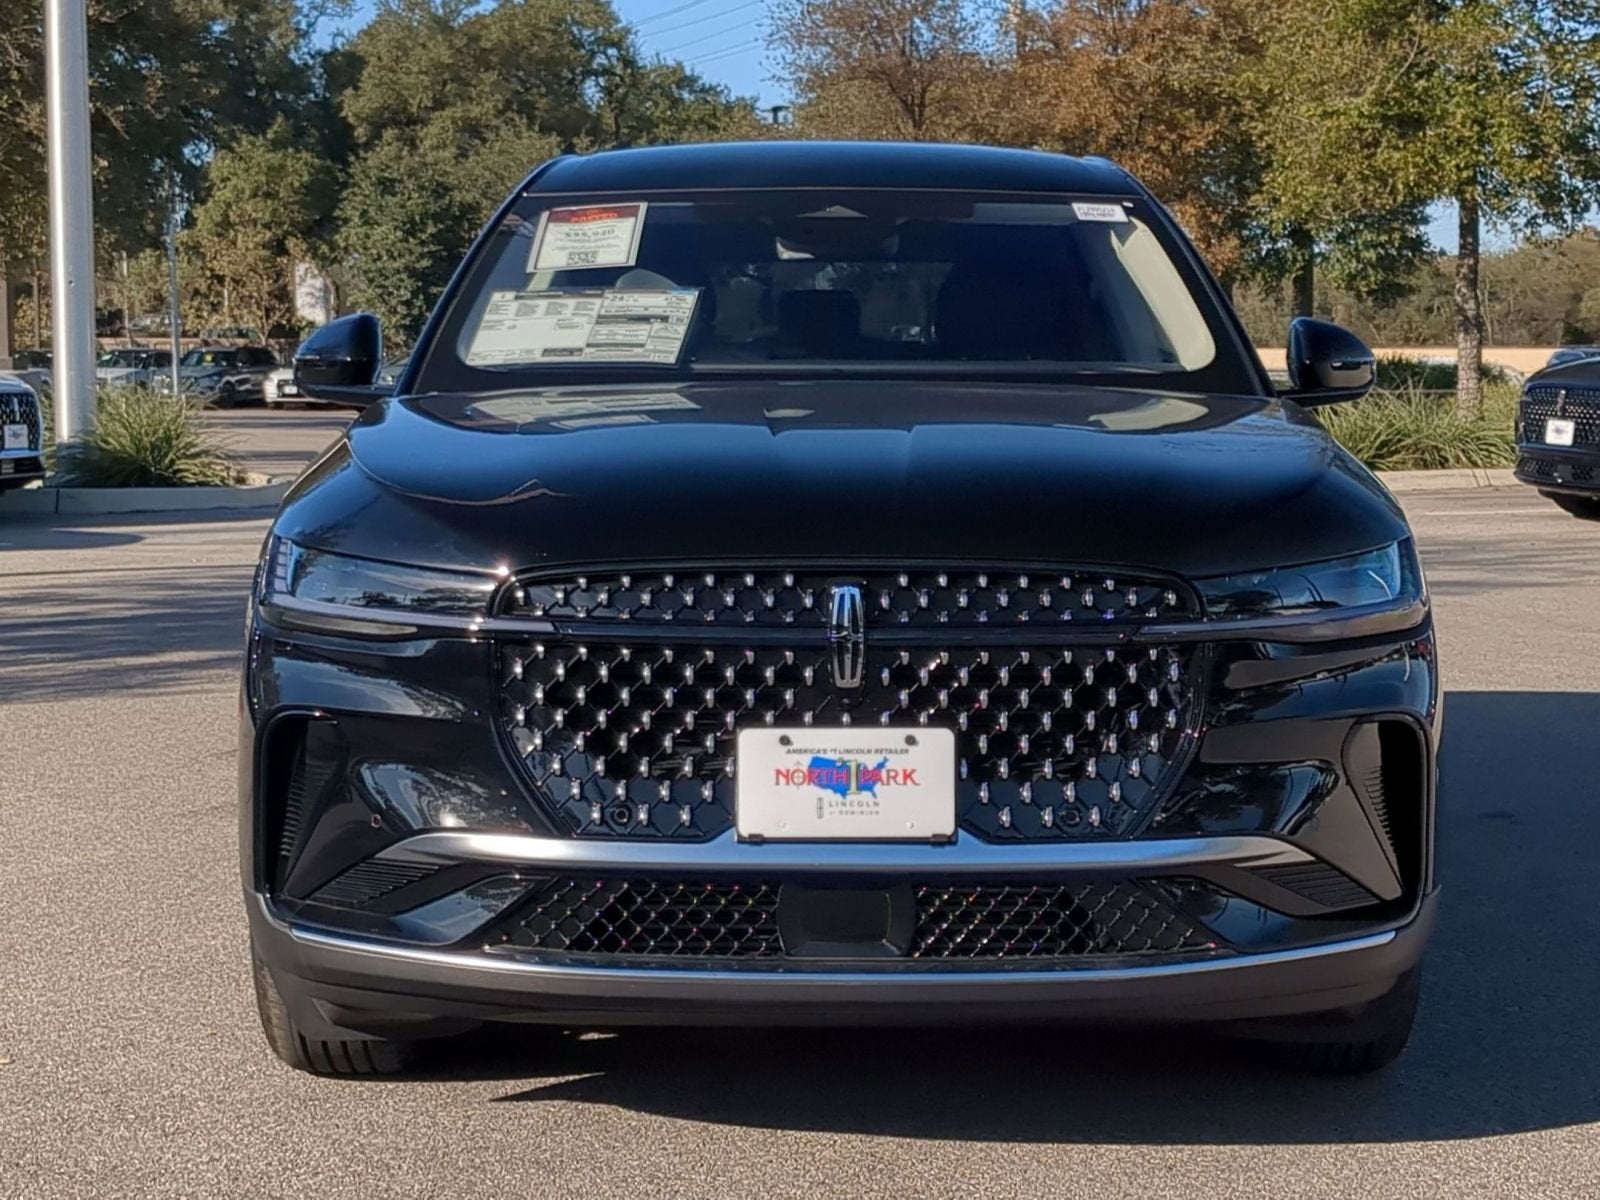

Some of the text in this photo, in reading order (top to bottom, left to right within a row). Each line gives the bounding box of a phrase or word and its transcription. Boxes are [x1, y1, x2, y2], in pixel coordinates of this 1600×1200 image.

[774, 768, 848, 786] NORTH
[861, 768, 920, 786] PARK
[828, 800, 880, 808] LINCOLN
